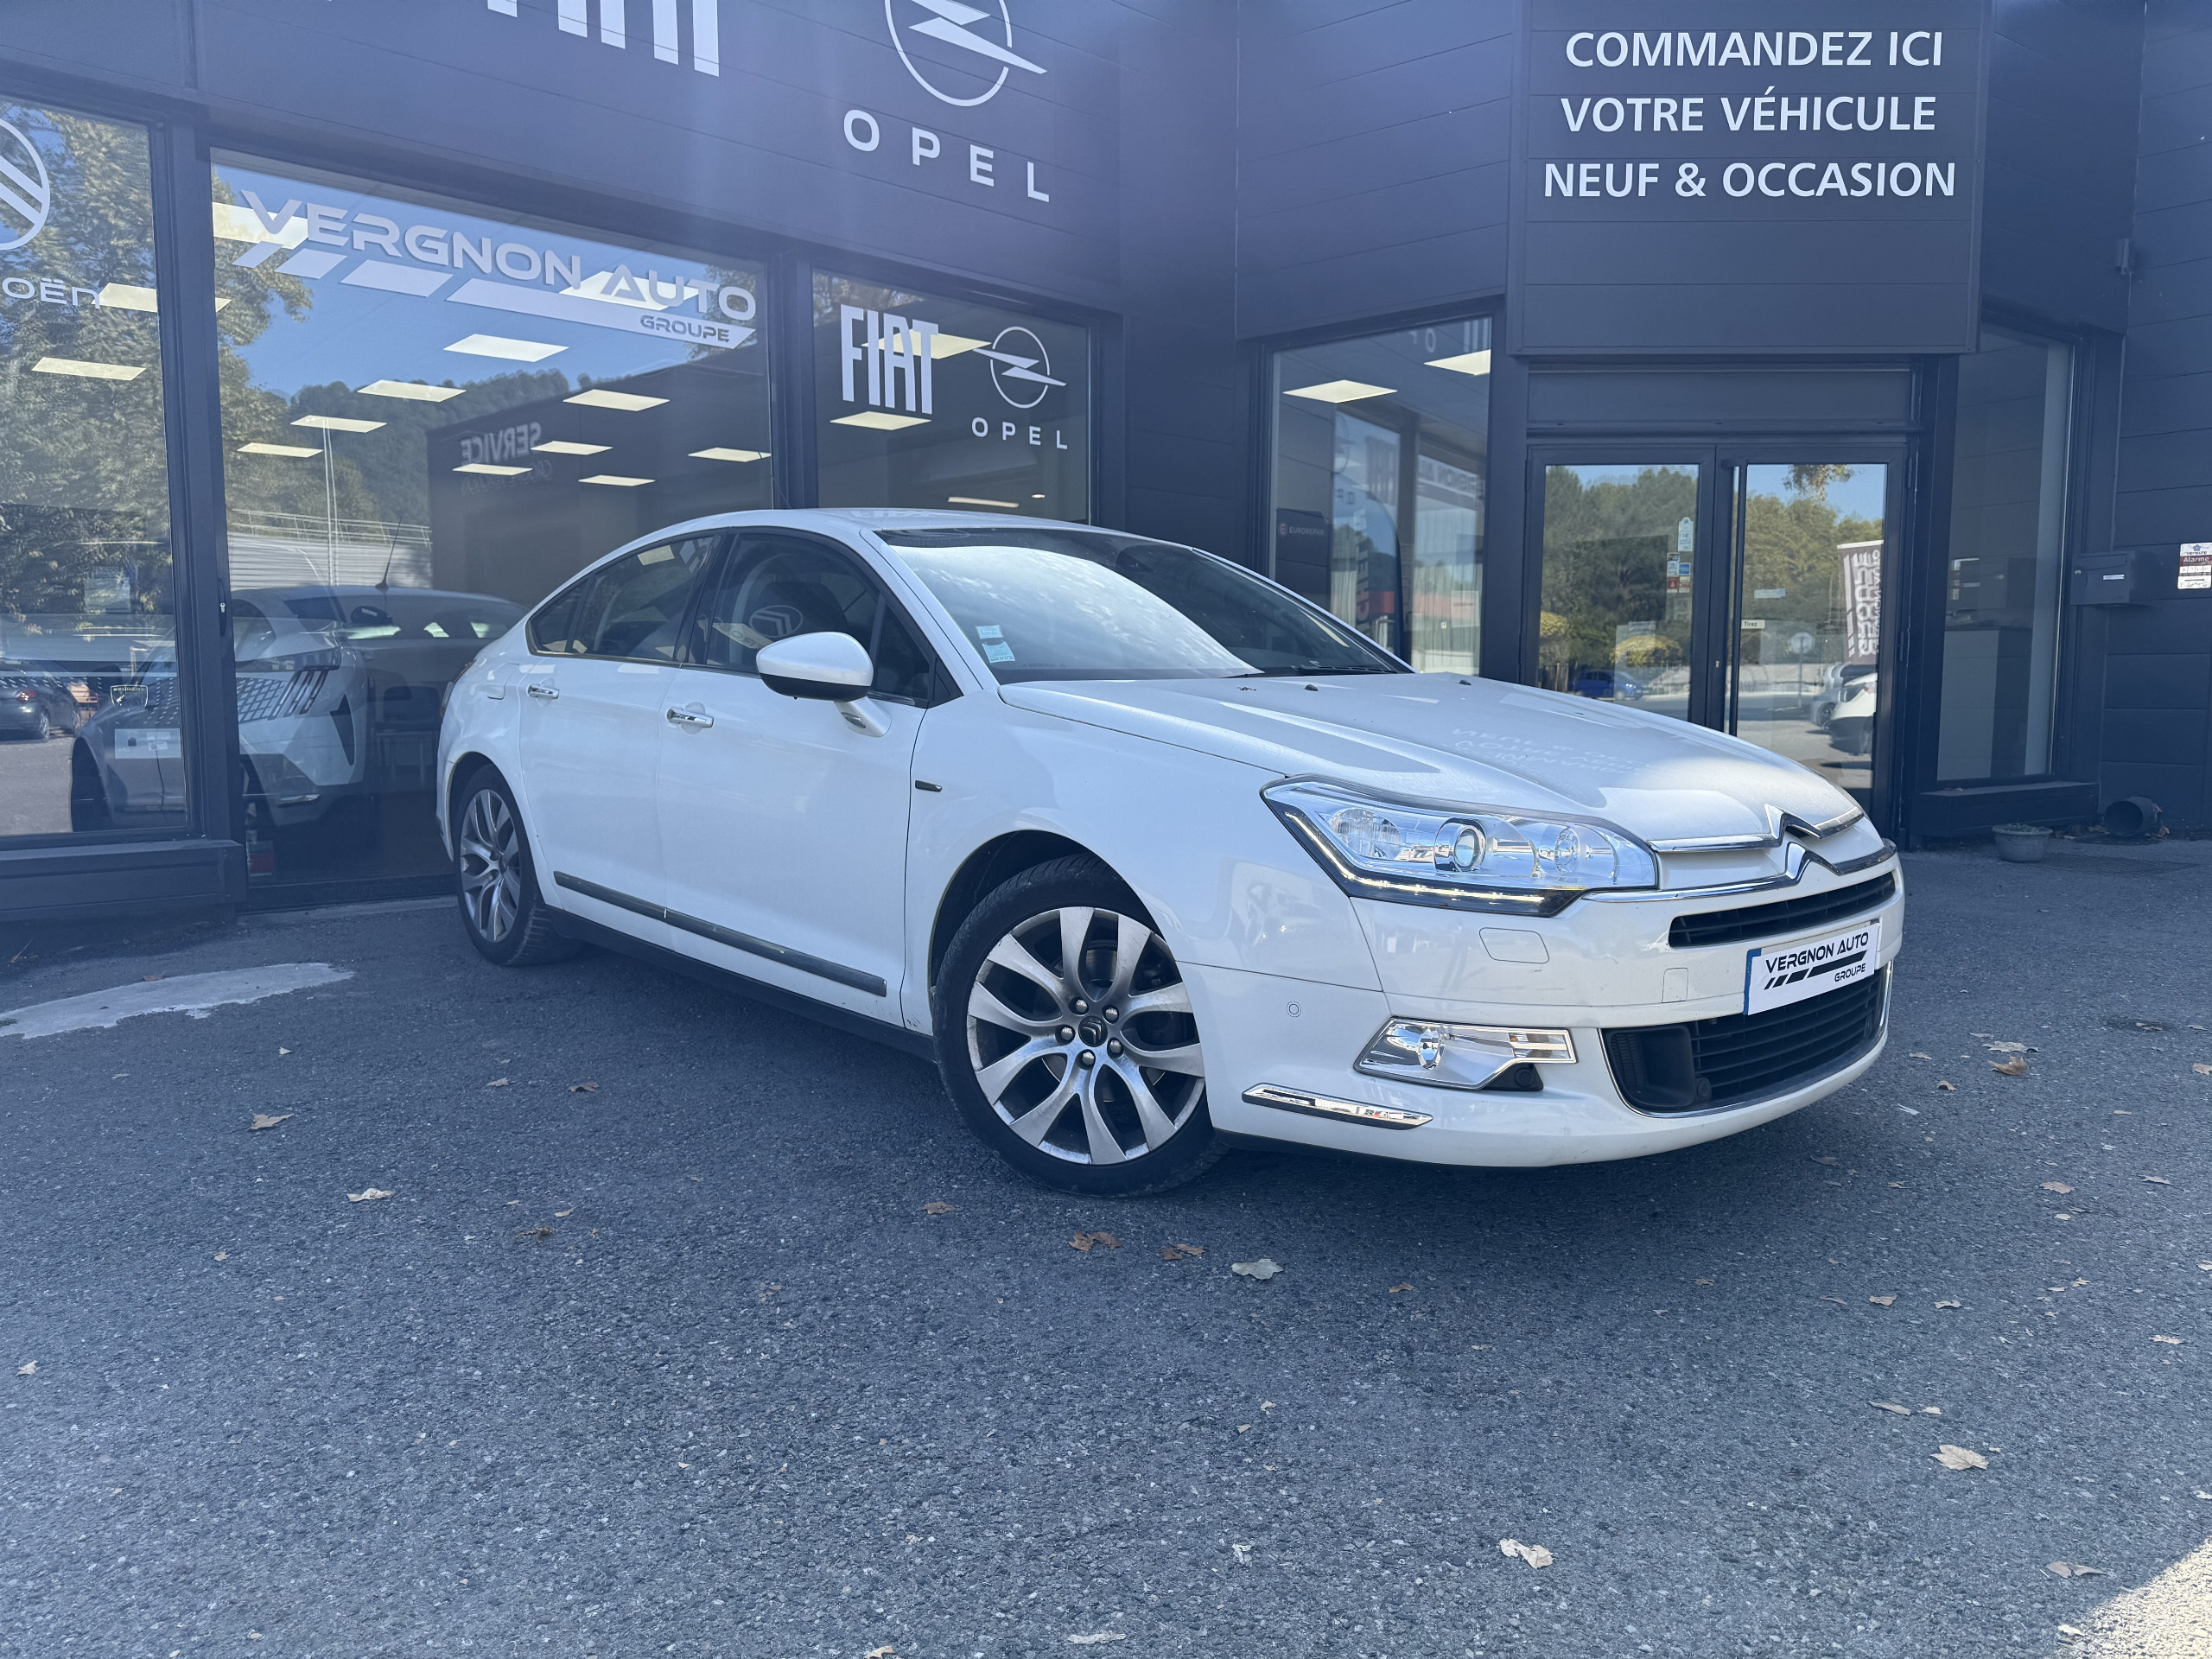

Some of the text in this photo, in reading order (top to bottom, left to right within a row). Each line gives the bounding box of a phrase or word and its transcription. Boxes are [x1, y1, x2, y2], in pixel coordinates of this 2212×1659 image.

[1566, 31, 1943, 67] COMMANDEZ ICI
[1561, 86, 1936, 132] VOTRE VÉHICULE
[843, 109, 1050, 203] OPEL
[1544, 162, 1956, 198] NEUF & OCCASION
[240, 189, 757, 321] VERGNON AUTO
[640, 315, 730, 342] GROUPE
[841, 303, 939, 415] FIAT
[971, 416, 1068, 450] OPEL
[1288, 525, 1325, 536] EUROREPAR
[1765, 931, 1869, 974] VERGNON AUTO
[1834, 963, 1866, 982] GROUPE
